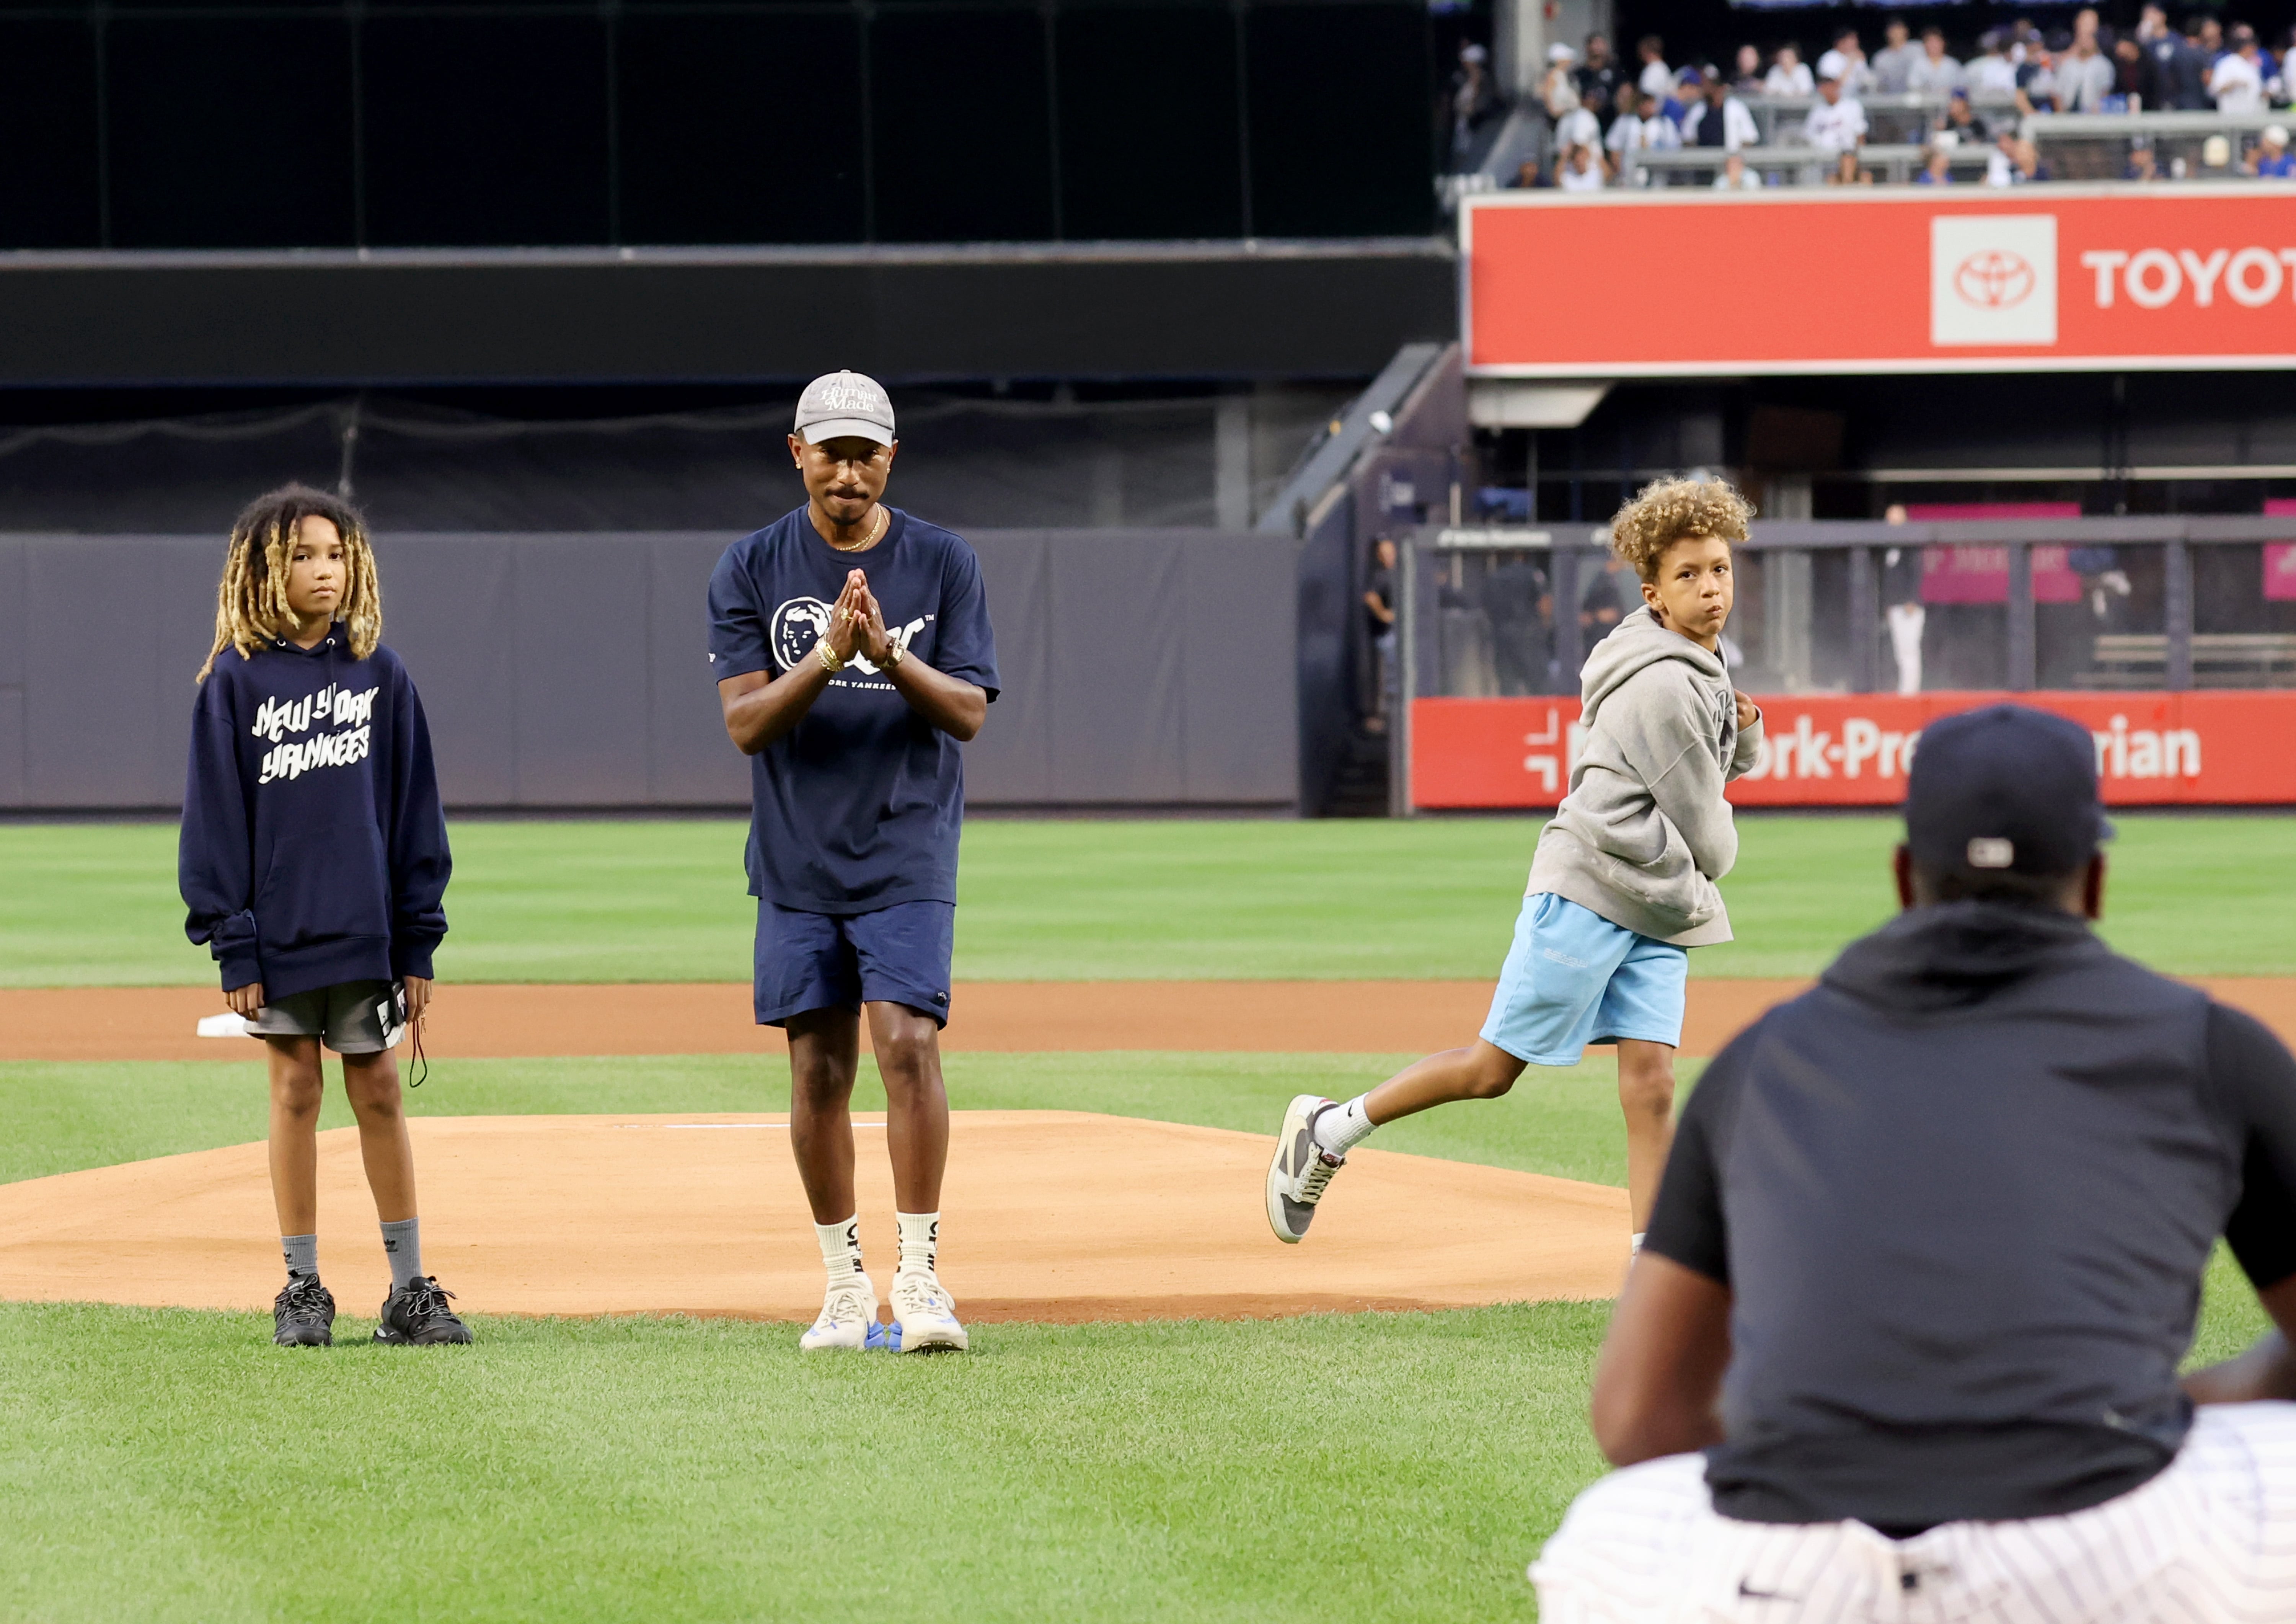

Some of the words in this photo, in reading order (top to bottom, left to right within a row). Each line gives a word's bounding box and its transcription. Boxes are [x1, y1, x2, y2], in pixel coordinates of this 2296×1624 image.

[819, 387, 877, 402] Human
[825, 396, 874, 412] Made
[251, 694, 312, 743] NEW
[311, 682, 379, 728] YORK
[258, 725, 371, 785] YANKEES
